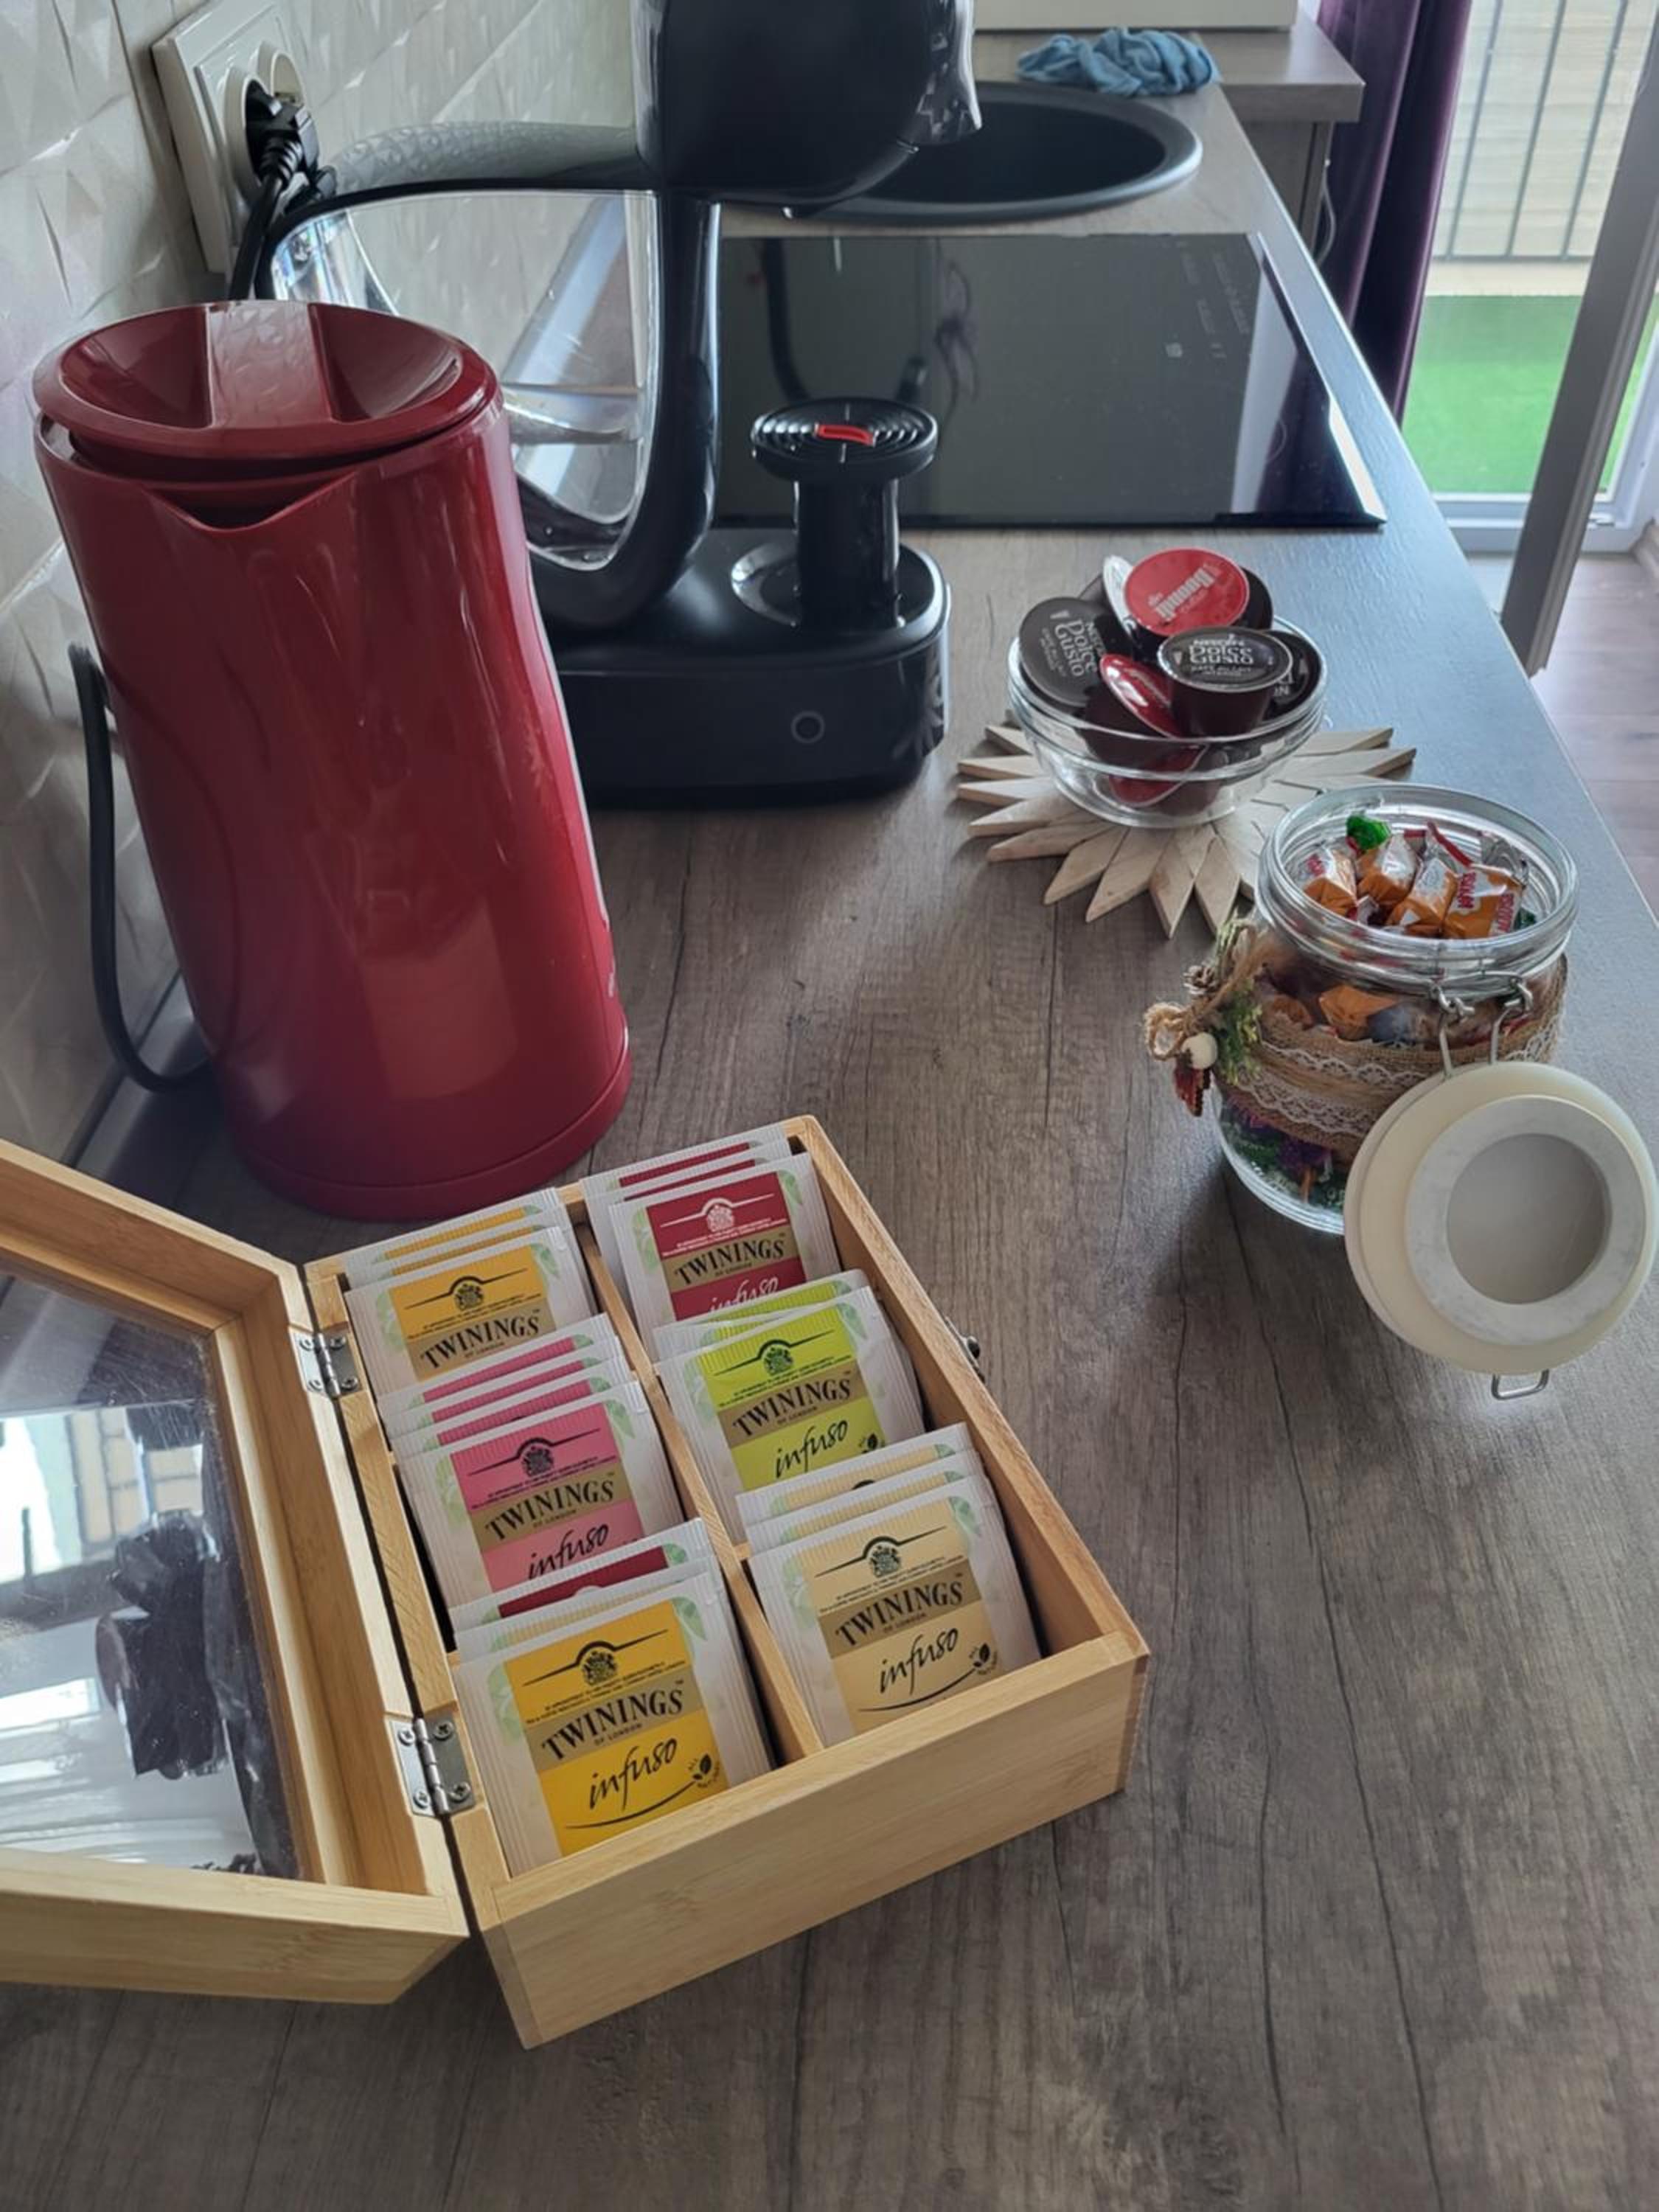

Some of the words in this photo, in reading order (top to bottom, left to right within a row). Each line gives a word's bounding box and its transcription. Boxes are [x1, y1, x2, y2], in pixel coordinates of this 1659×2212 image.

[1054, 623, 1085, 677] Gusto
[674, 1238, 785, 1285] TWININGS
[419, 1315, 540, 1369] TWININGS
[732, 1378, 851, 1436] TWININGS
[775, 1419, 848, 1479] infuso
[484, 1480, 614, 1541] TWININGS
[528, 1523, 609, 1580] infuso
[835, 1580, 963, 1646] TWININGS
[879, 1627, 959, 1695] infuso
[540, 1688, 684, 1761] TWININGS
[588, 1737, 678, 1811] infuso
